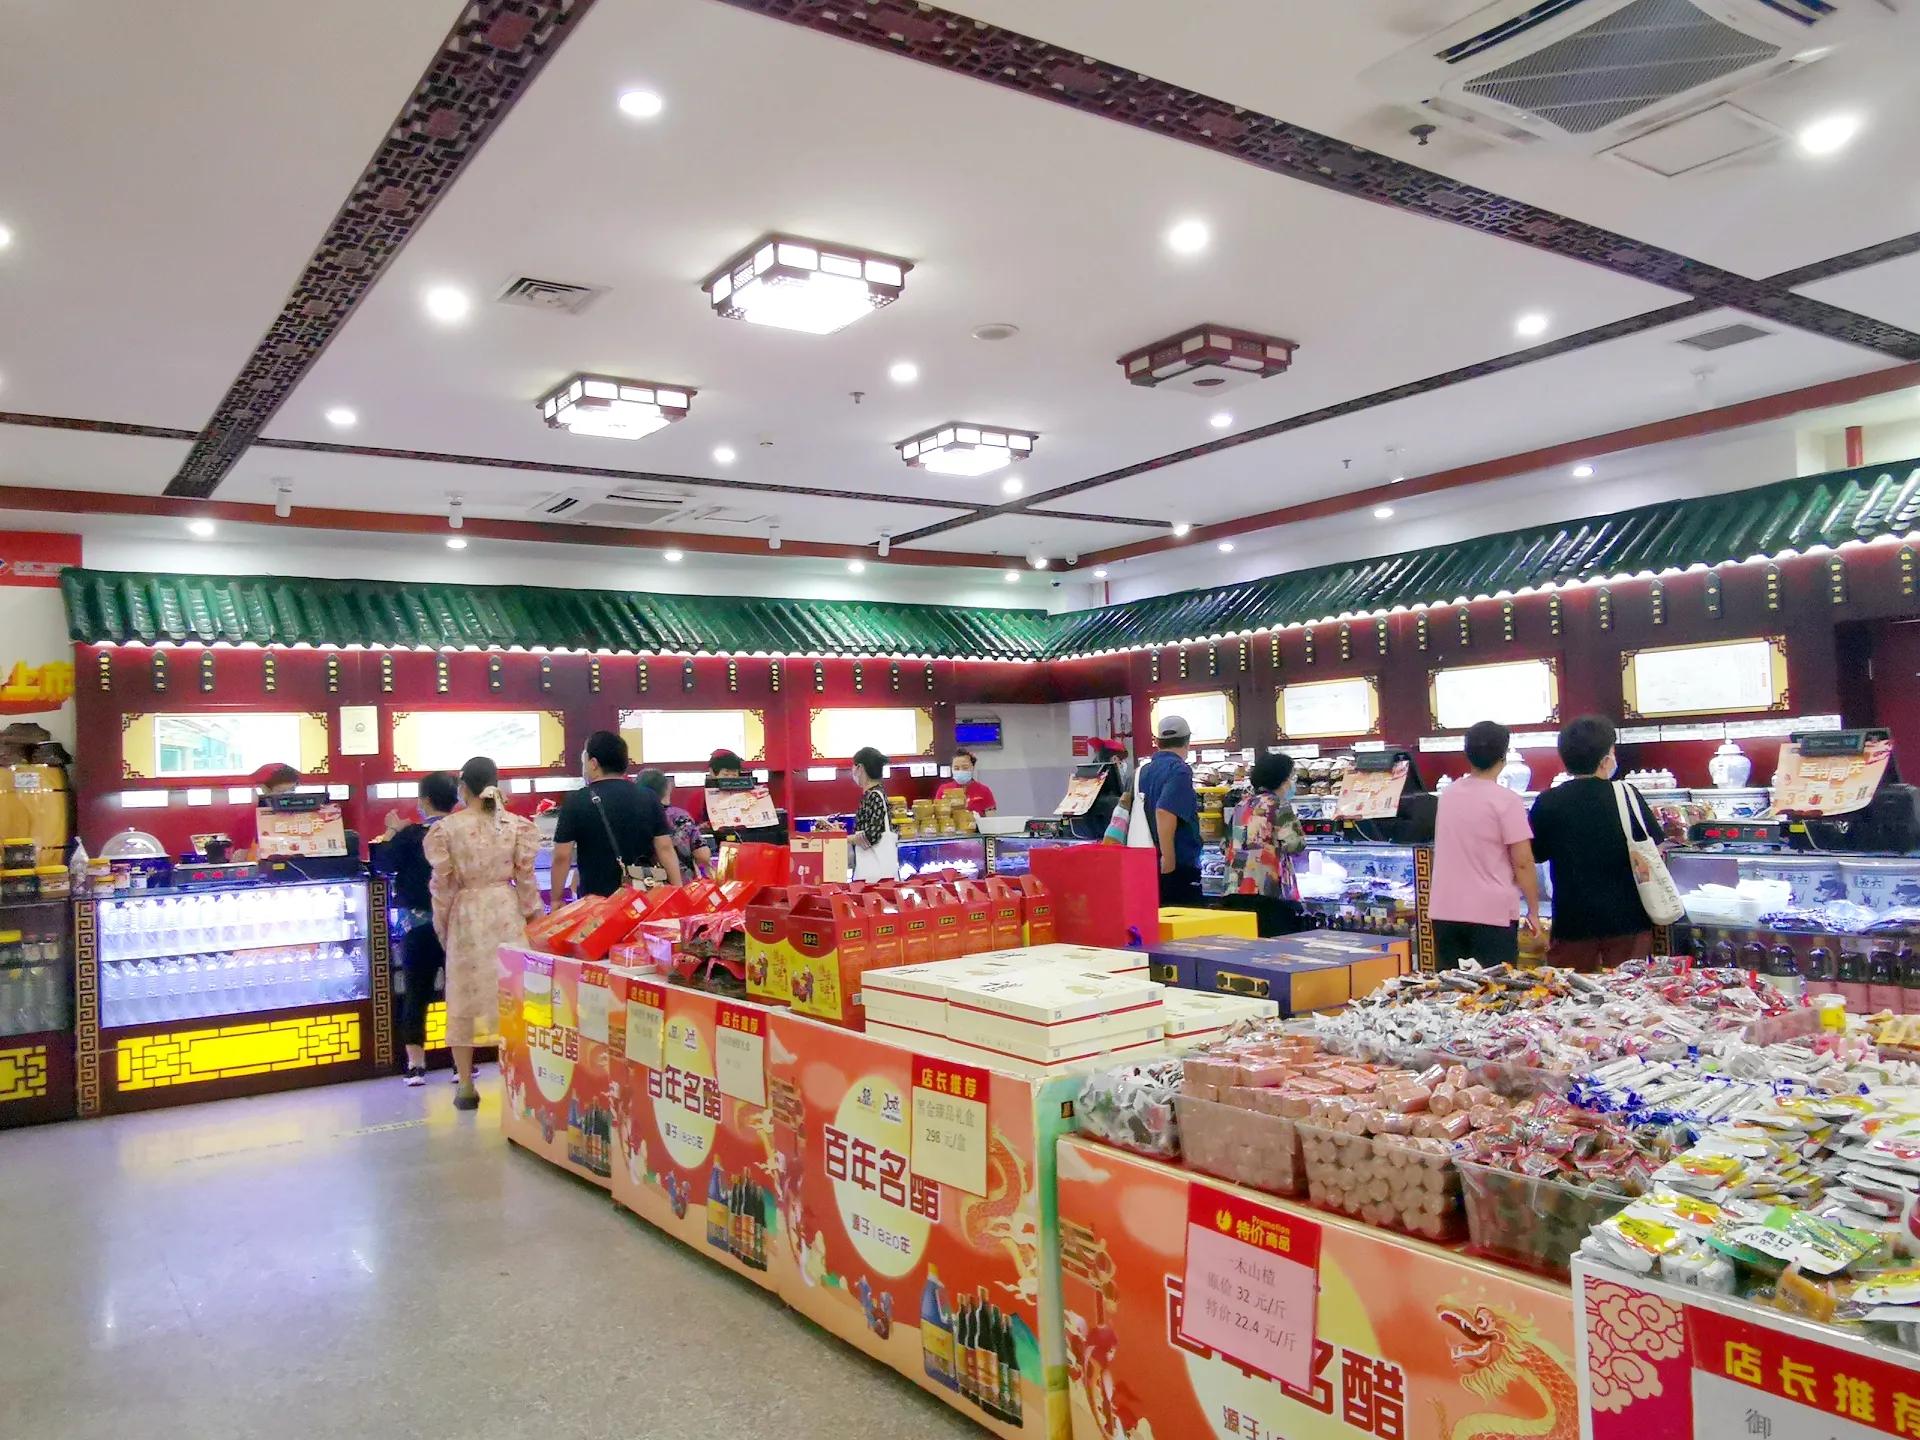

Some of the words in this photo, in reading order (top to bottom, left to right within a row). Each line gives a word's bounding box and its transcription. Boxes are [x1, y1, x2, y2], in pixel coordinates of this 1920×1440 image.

[921, 1068, 977, 1098] 店长推荐
[926, 1128, 941, 1144] 298
[825, 1126, 940, 1221] 百年名醋
[852, 1213, 912, 1255] 源于1820年
[1236, 1219, 1291, 1253] 特价商品
[1251, 1215, 1291, 1235] Promotion
[1236, 1285, 1250, 1304] 32
[1254, 1294, 1288, 1320] 元/斤
[1205, 1298, 1232, 1325] 特价
[1234, 1312, 1260, 1335] 22.4
[1263, 1324, 1297, 1353] 元/斤
